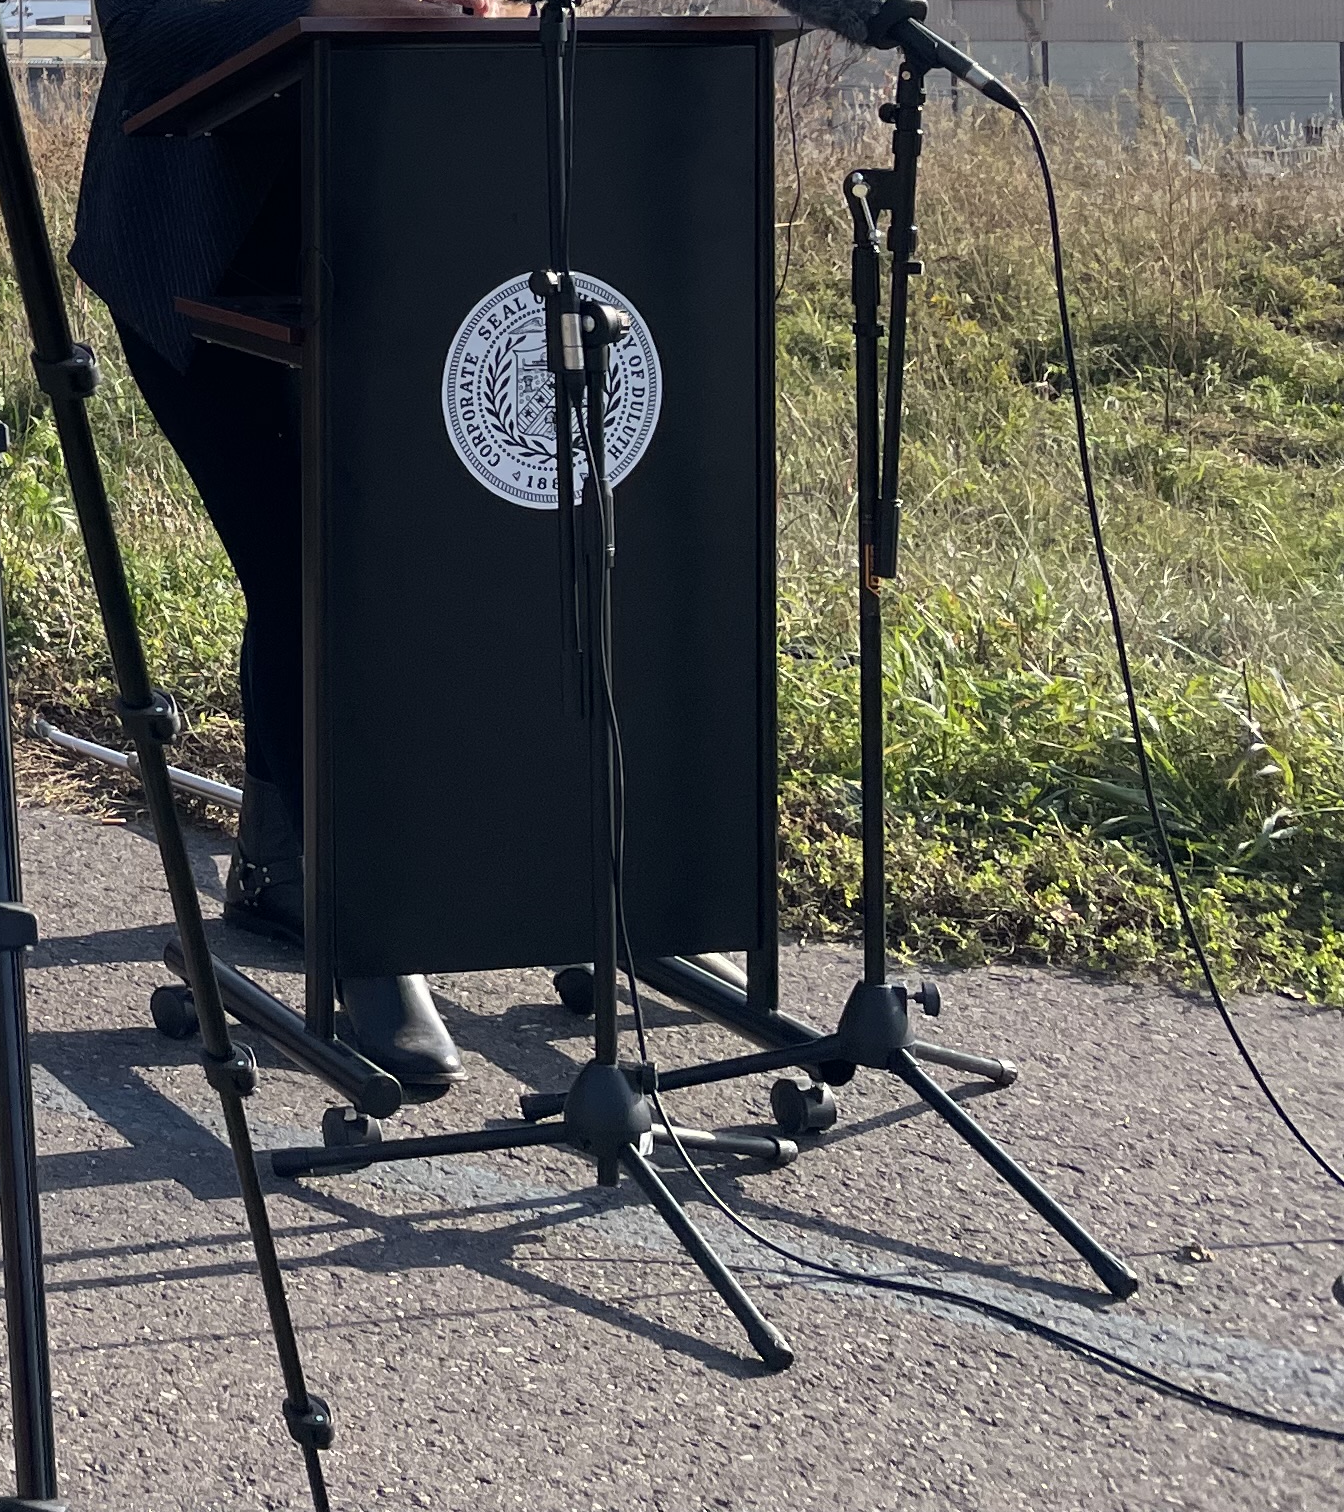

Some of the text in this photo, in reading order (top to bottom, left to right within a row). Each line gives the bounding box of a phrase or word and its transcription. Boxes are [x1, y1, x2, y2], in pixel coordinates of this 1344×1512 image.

[478, 297, 527, 341] SEAL
[628, 355, 645, 380] OF
[460, 352, 500, 467] CORPORATE
[607, 387, 645, 461] DULUTH
